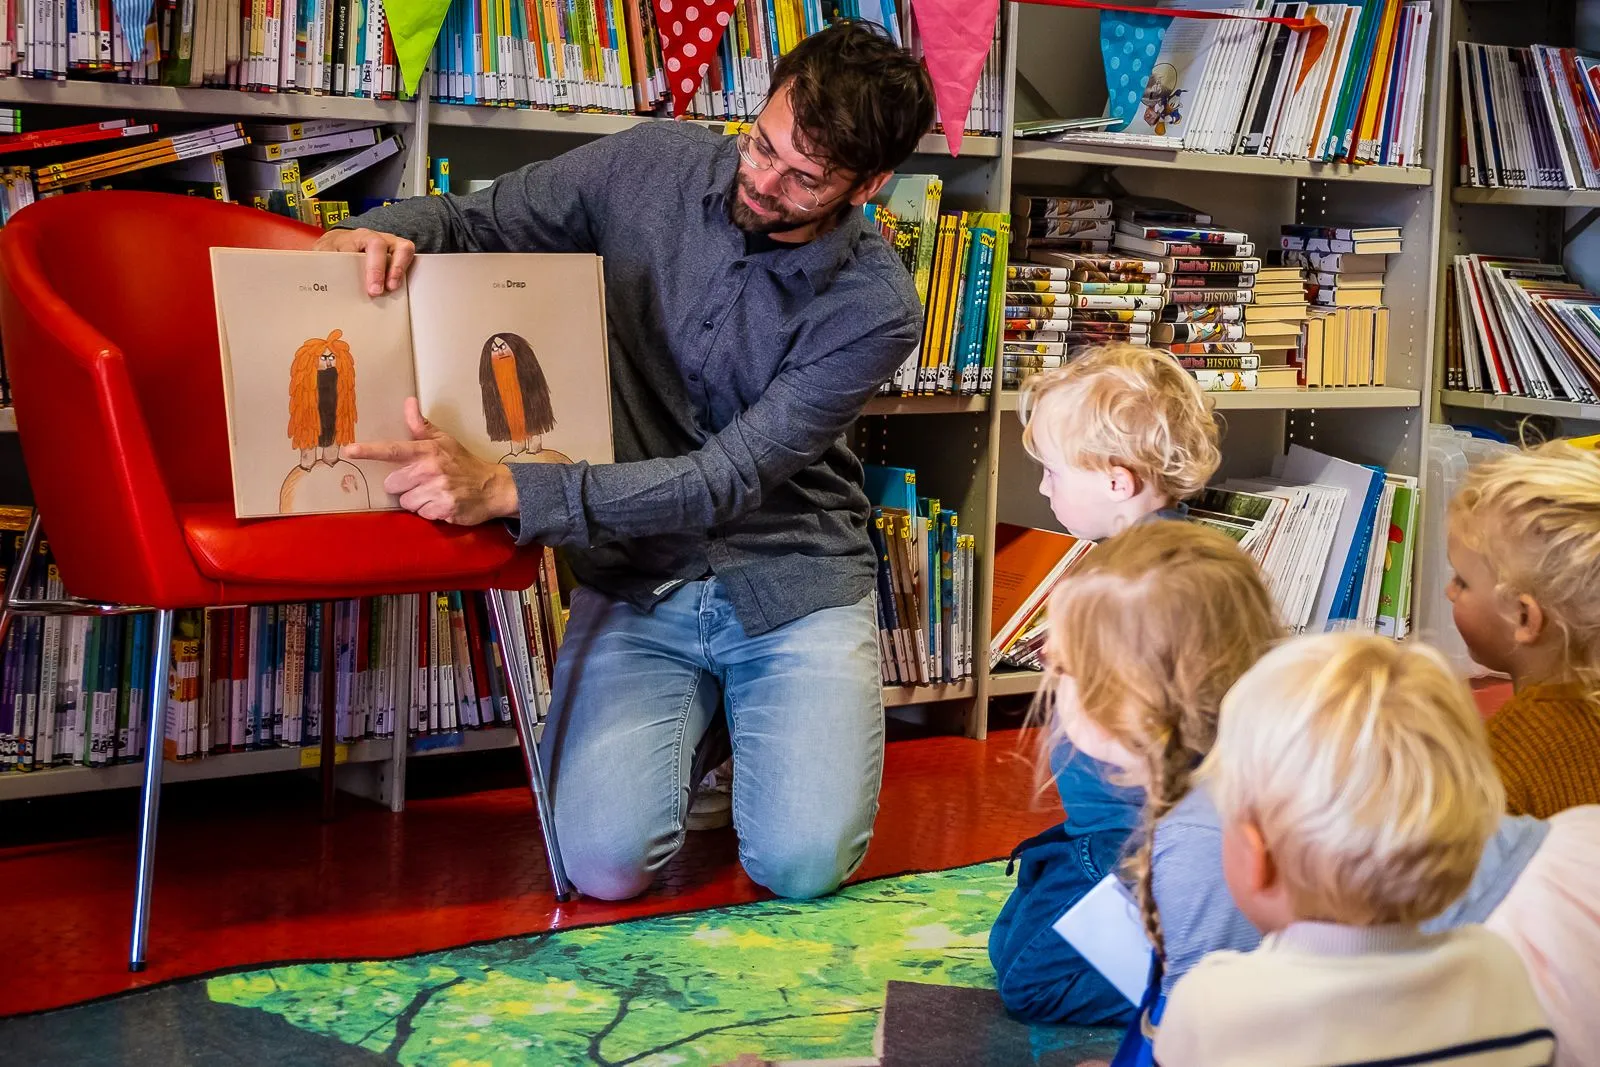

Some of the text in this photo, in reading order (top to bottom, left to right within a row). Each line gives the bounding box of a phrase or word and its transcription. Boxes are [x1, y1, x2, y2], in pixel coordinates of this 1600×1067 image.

[293, 128, 301, 136] R
[270, 146, 279, 155] R
[442, 164, 448, 172] V
[16, 170, 23, 178] R
[7, 178, 15, 187] R
[306, 182, 314, 192] R
[216, 188, 223, 197] R
[506, 280, 526, 288] Drap
[42, 542, 48, 551] S
[50, 568, 56, 576] S
